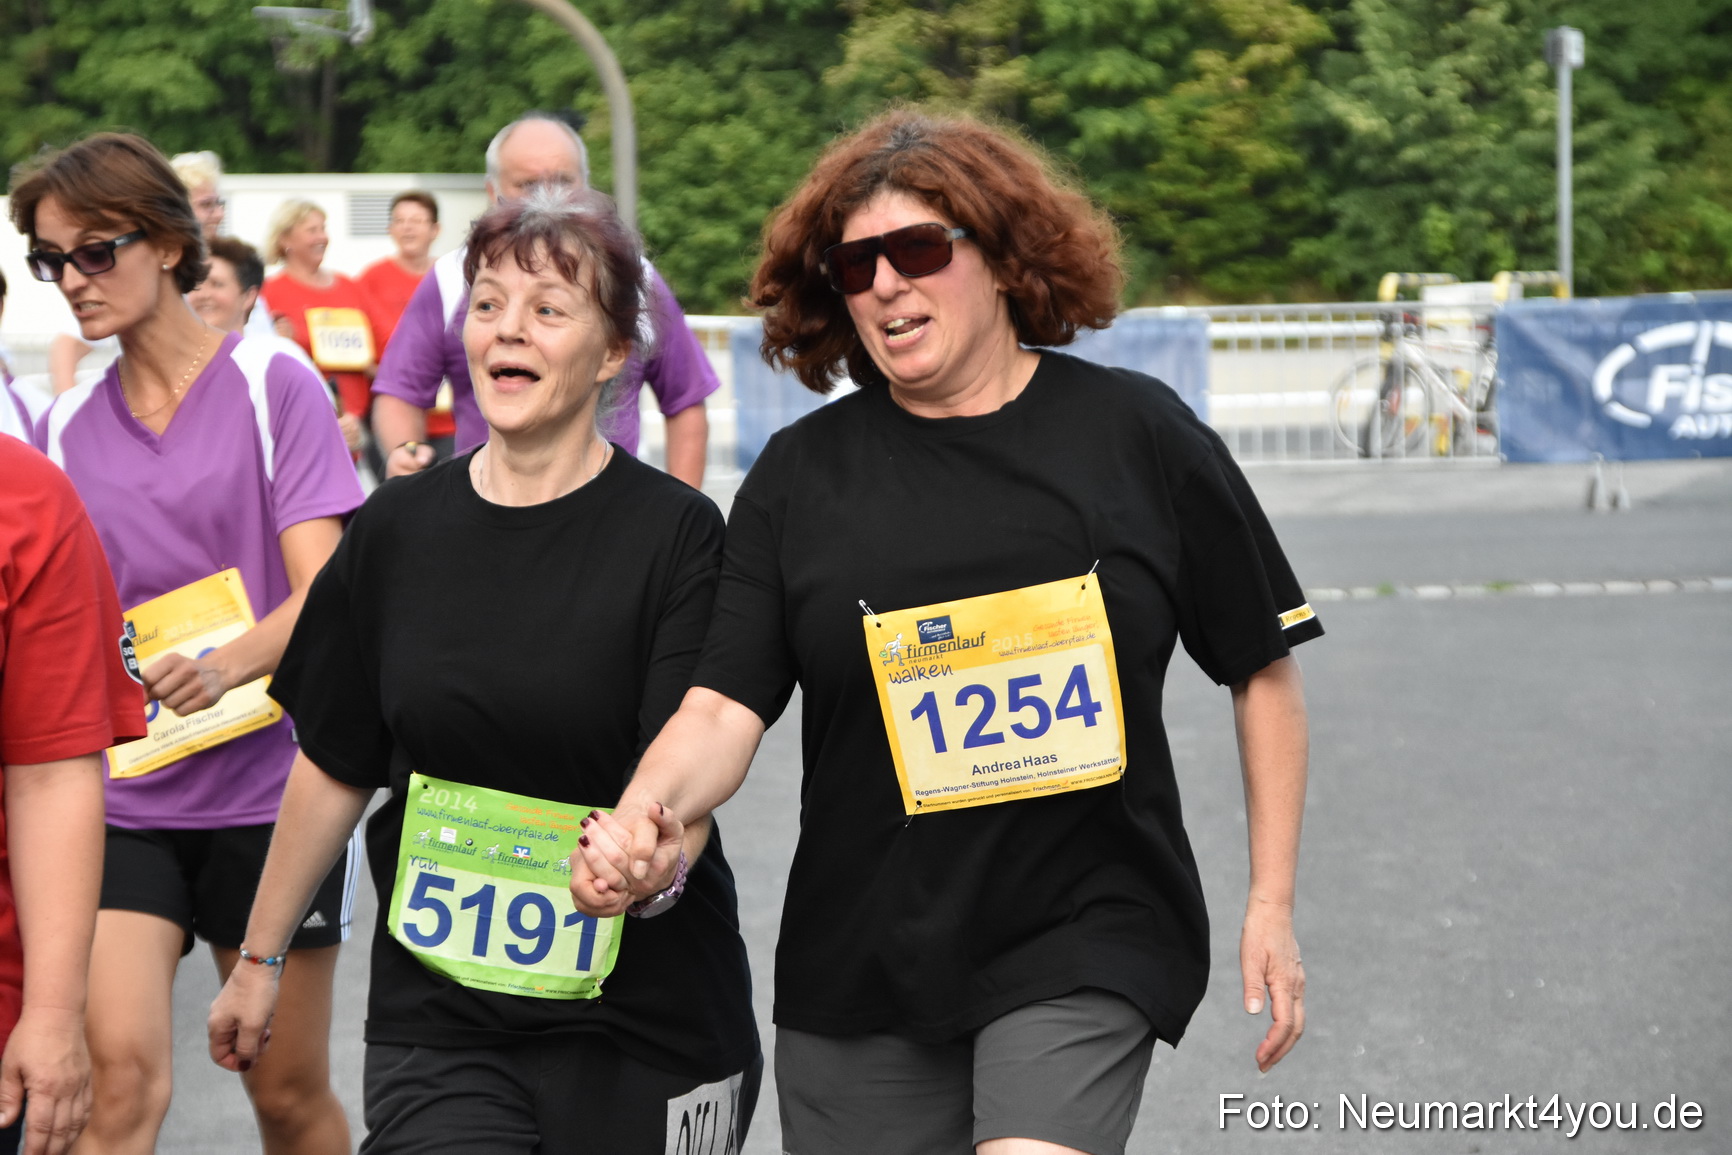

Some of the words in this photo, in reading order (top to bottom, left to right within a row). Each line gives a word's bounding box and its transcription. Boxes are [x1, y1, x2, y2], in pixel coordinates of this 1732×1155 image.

[906, 631, 986, 659] firmenlauf
[991, 632, 1034, 653] 2015
[908, 653, 944, 664] neumarkt
[888, 664, 954, 685] walken
[910, 663, 1103, 754] 1254
[153, 723, 185, 742] Carola
[185, 708, 225, 729] Fischer
[972, 760, 1022, 776] Andrea
[1023, 753, 1058, 768] Haas
[915, 779, 999, 797] Regens-Wagner-Stiftung
[1037, 766, 1077, 778] Holnsteiner
[419, 785, 478, 814] 2014
[428, 837, 478, 856] firmenlauf
[497, 851, 549, 869] firmenlauf
[302, 920, 327, 929] adidas
[403, 871, 599, 972] 5191
